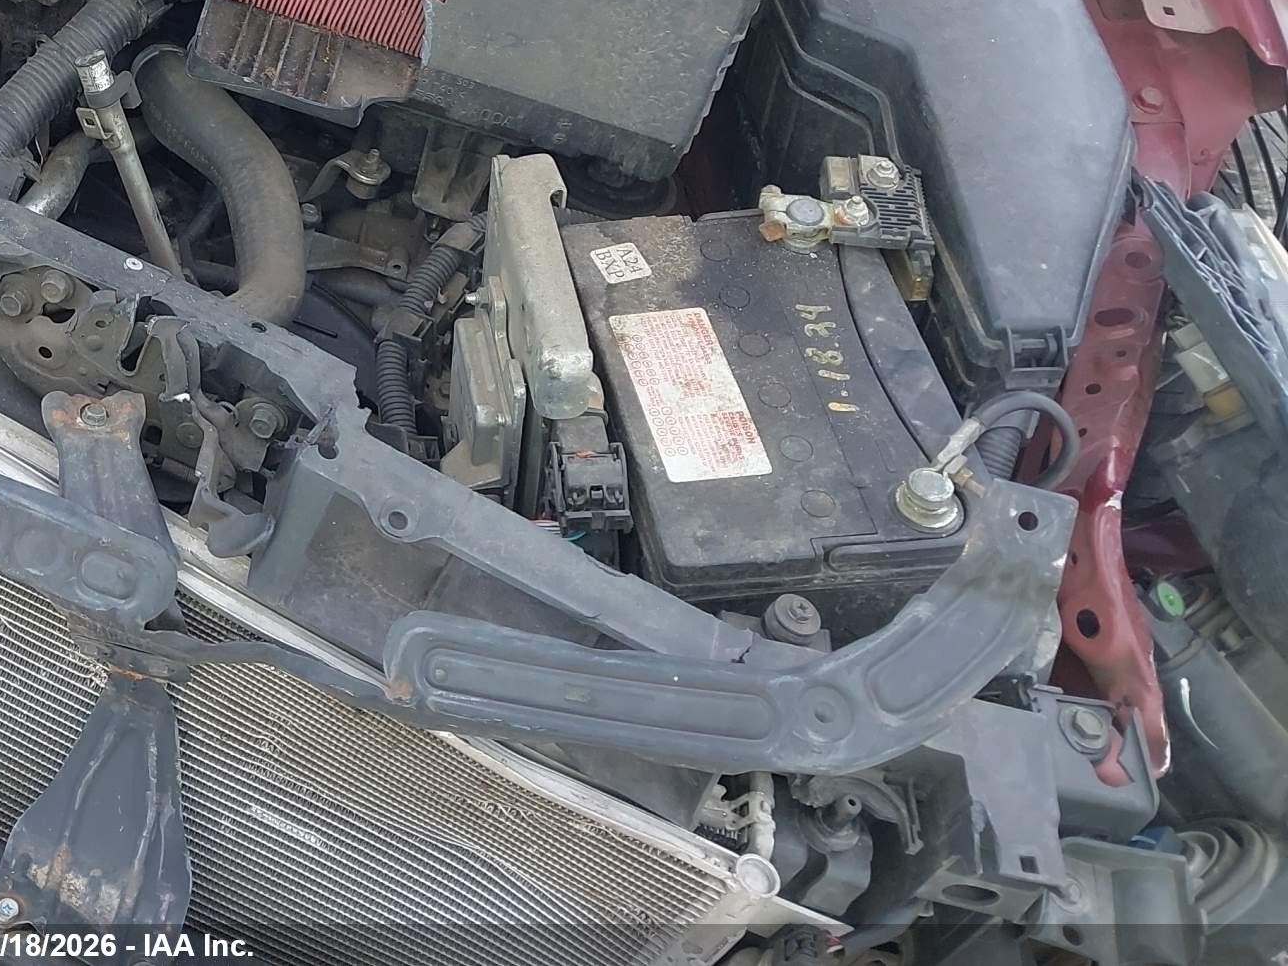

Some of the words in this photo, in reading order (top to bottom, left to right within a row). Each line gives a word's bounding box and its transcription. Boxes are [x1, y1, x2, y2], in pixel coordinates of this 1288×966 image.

[595, 250, 625, 278] BXP
[694, 313, 714, 346] DANGER
[736, 410, 756, 444] POISON
